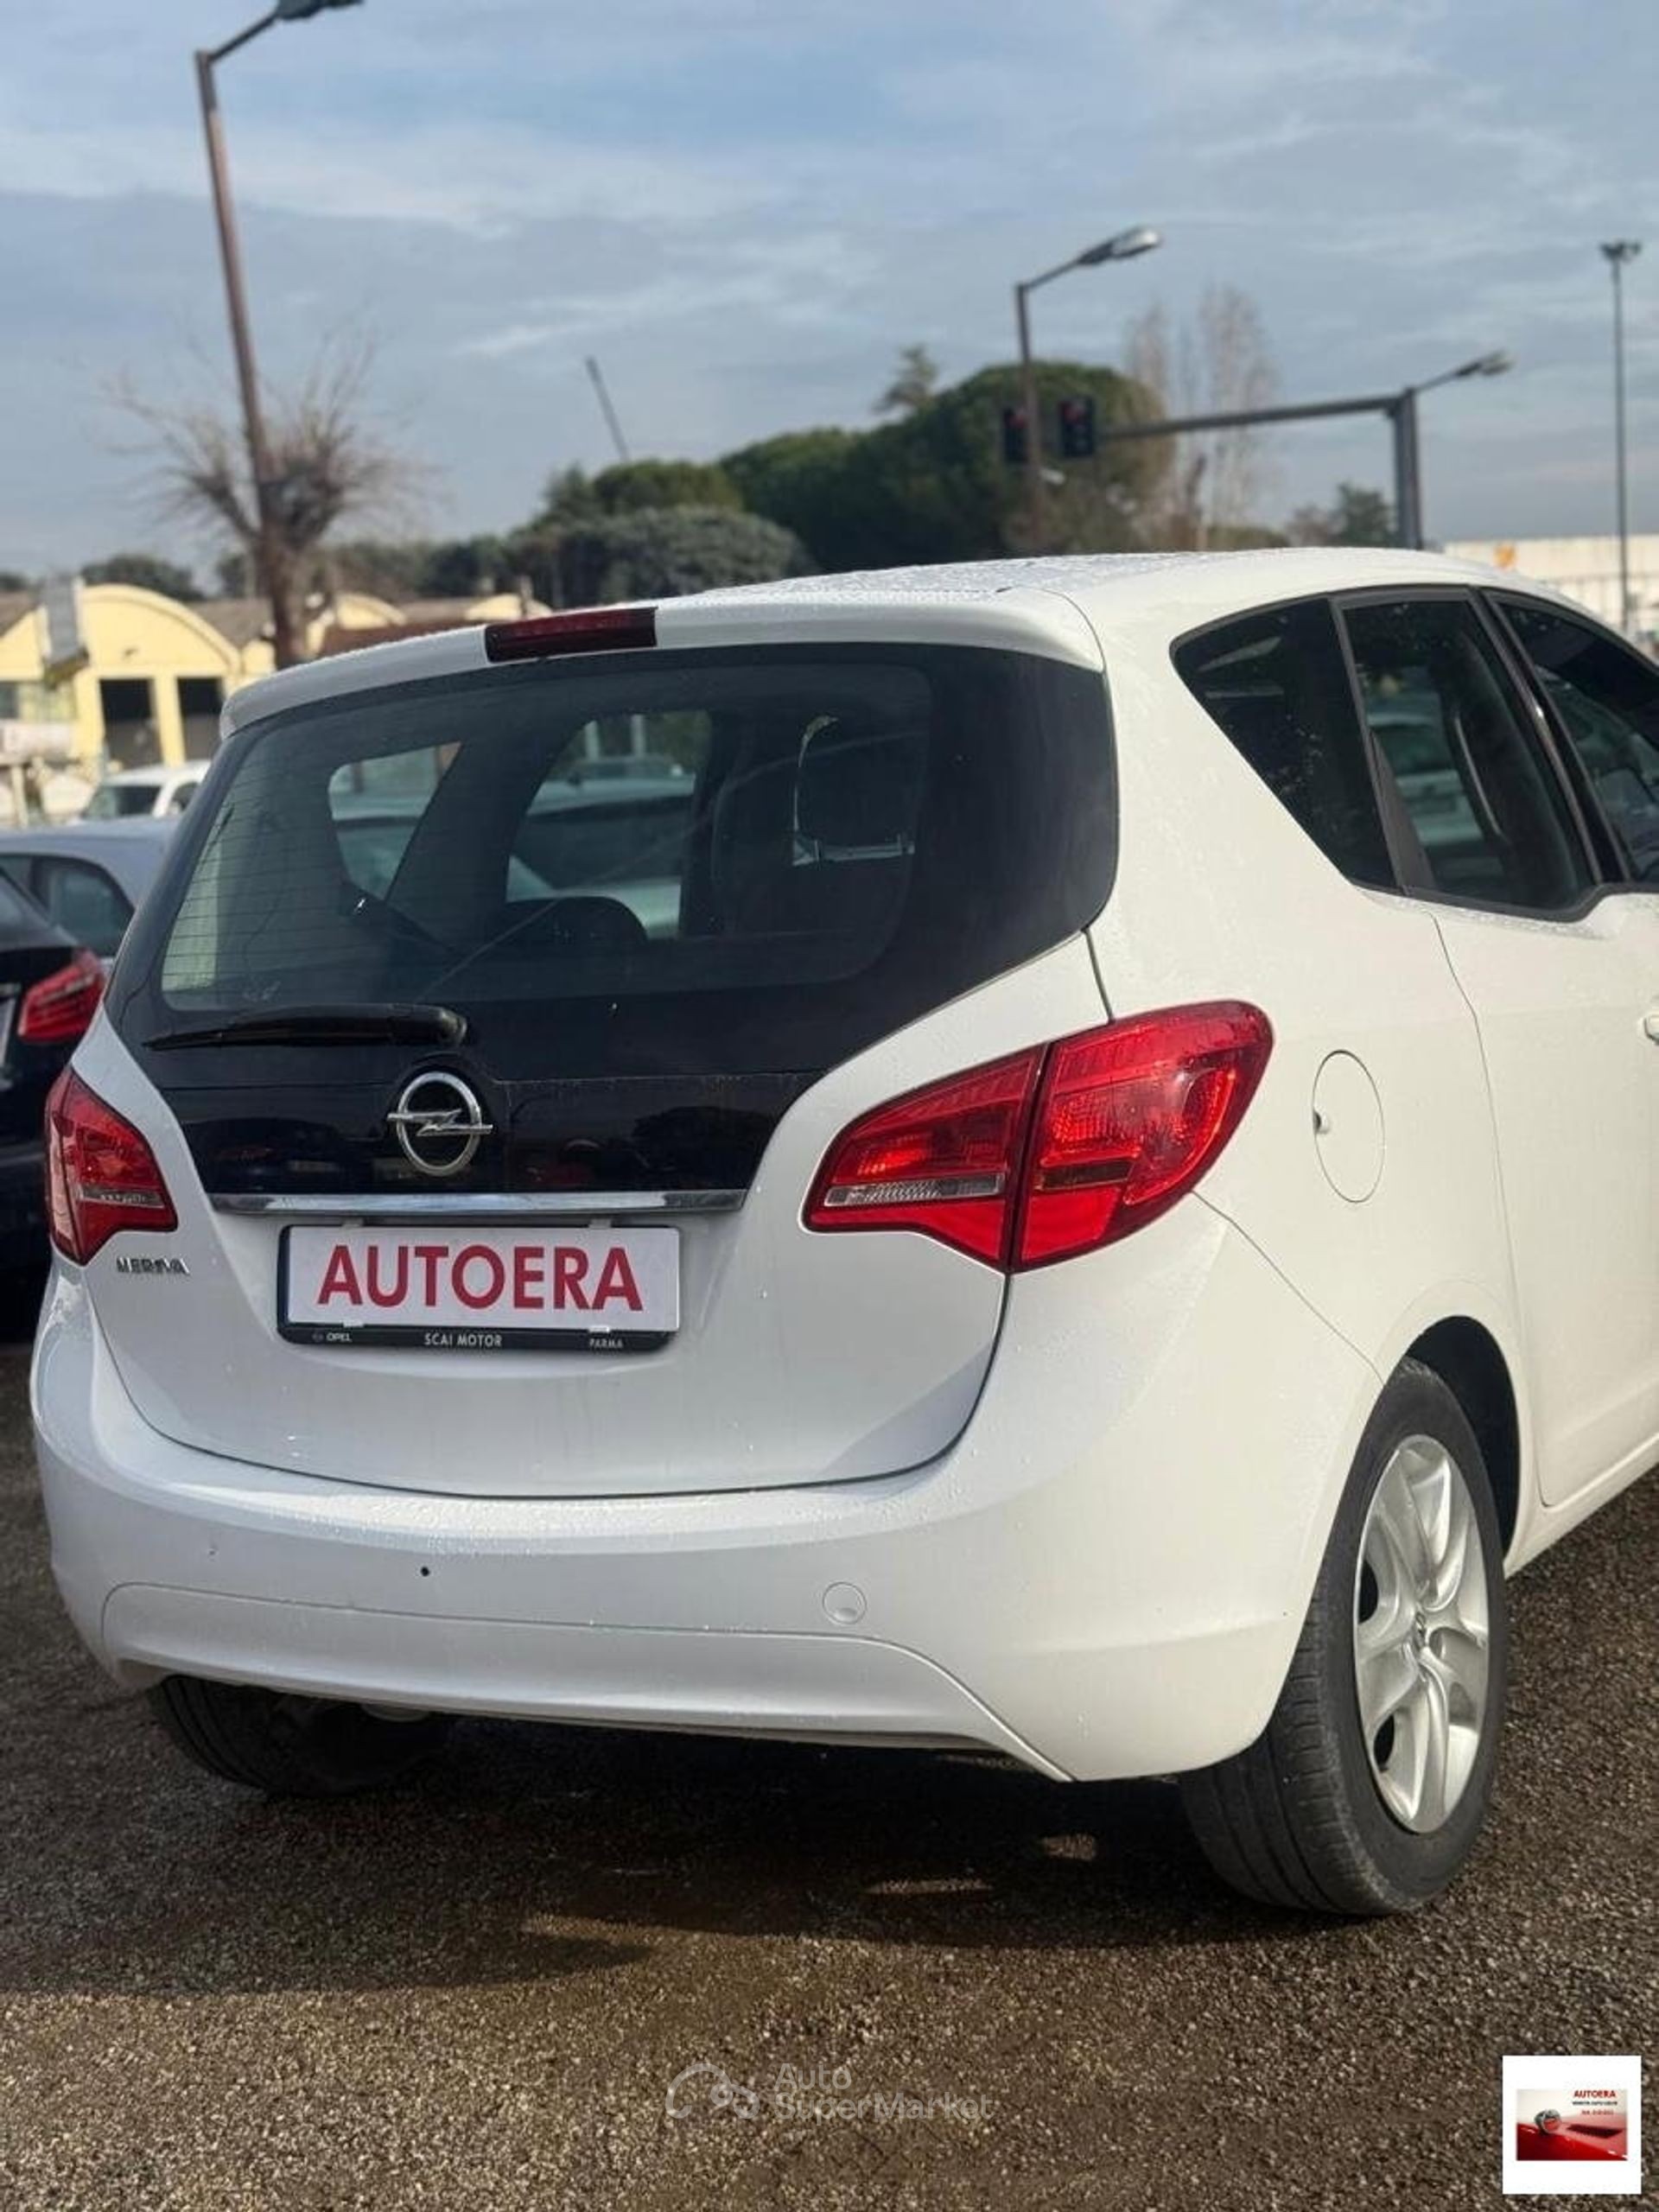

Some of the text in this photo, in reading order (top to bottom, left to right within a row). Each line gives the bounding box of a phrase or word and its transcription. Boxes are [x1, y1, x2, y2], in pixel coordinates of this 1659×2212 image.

[317, 1244, 644, 1312] AUTOERA
[326, 1332, 624, 1348] OPEL SCAI MOTOR PARMA
